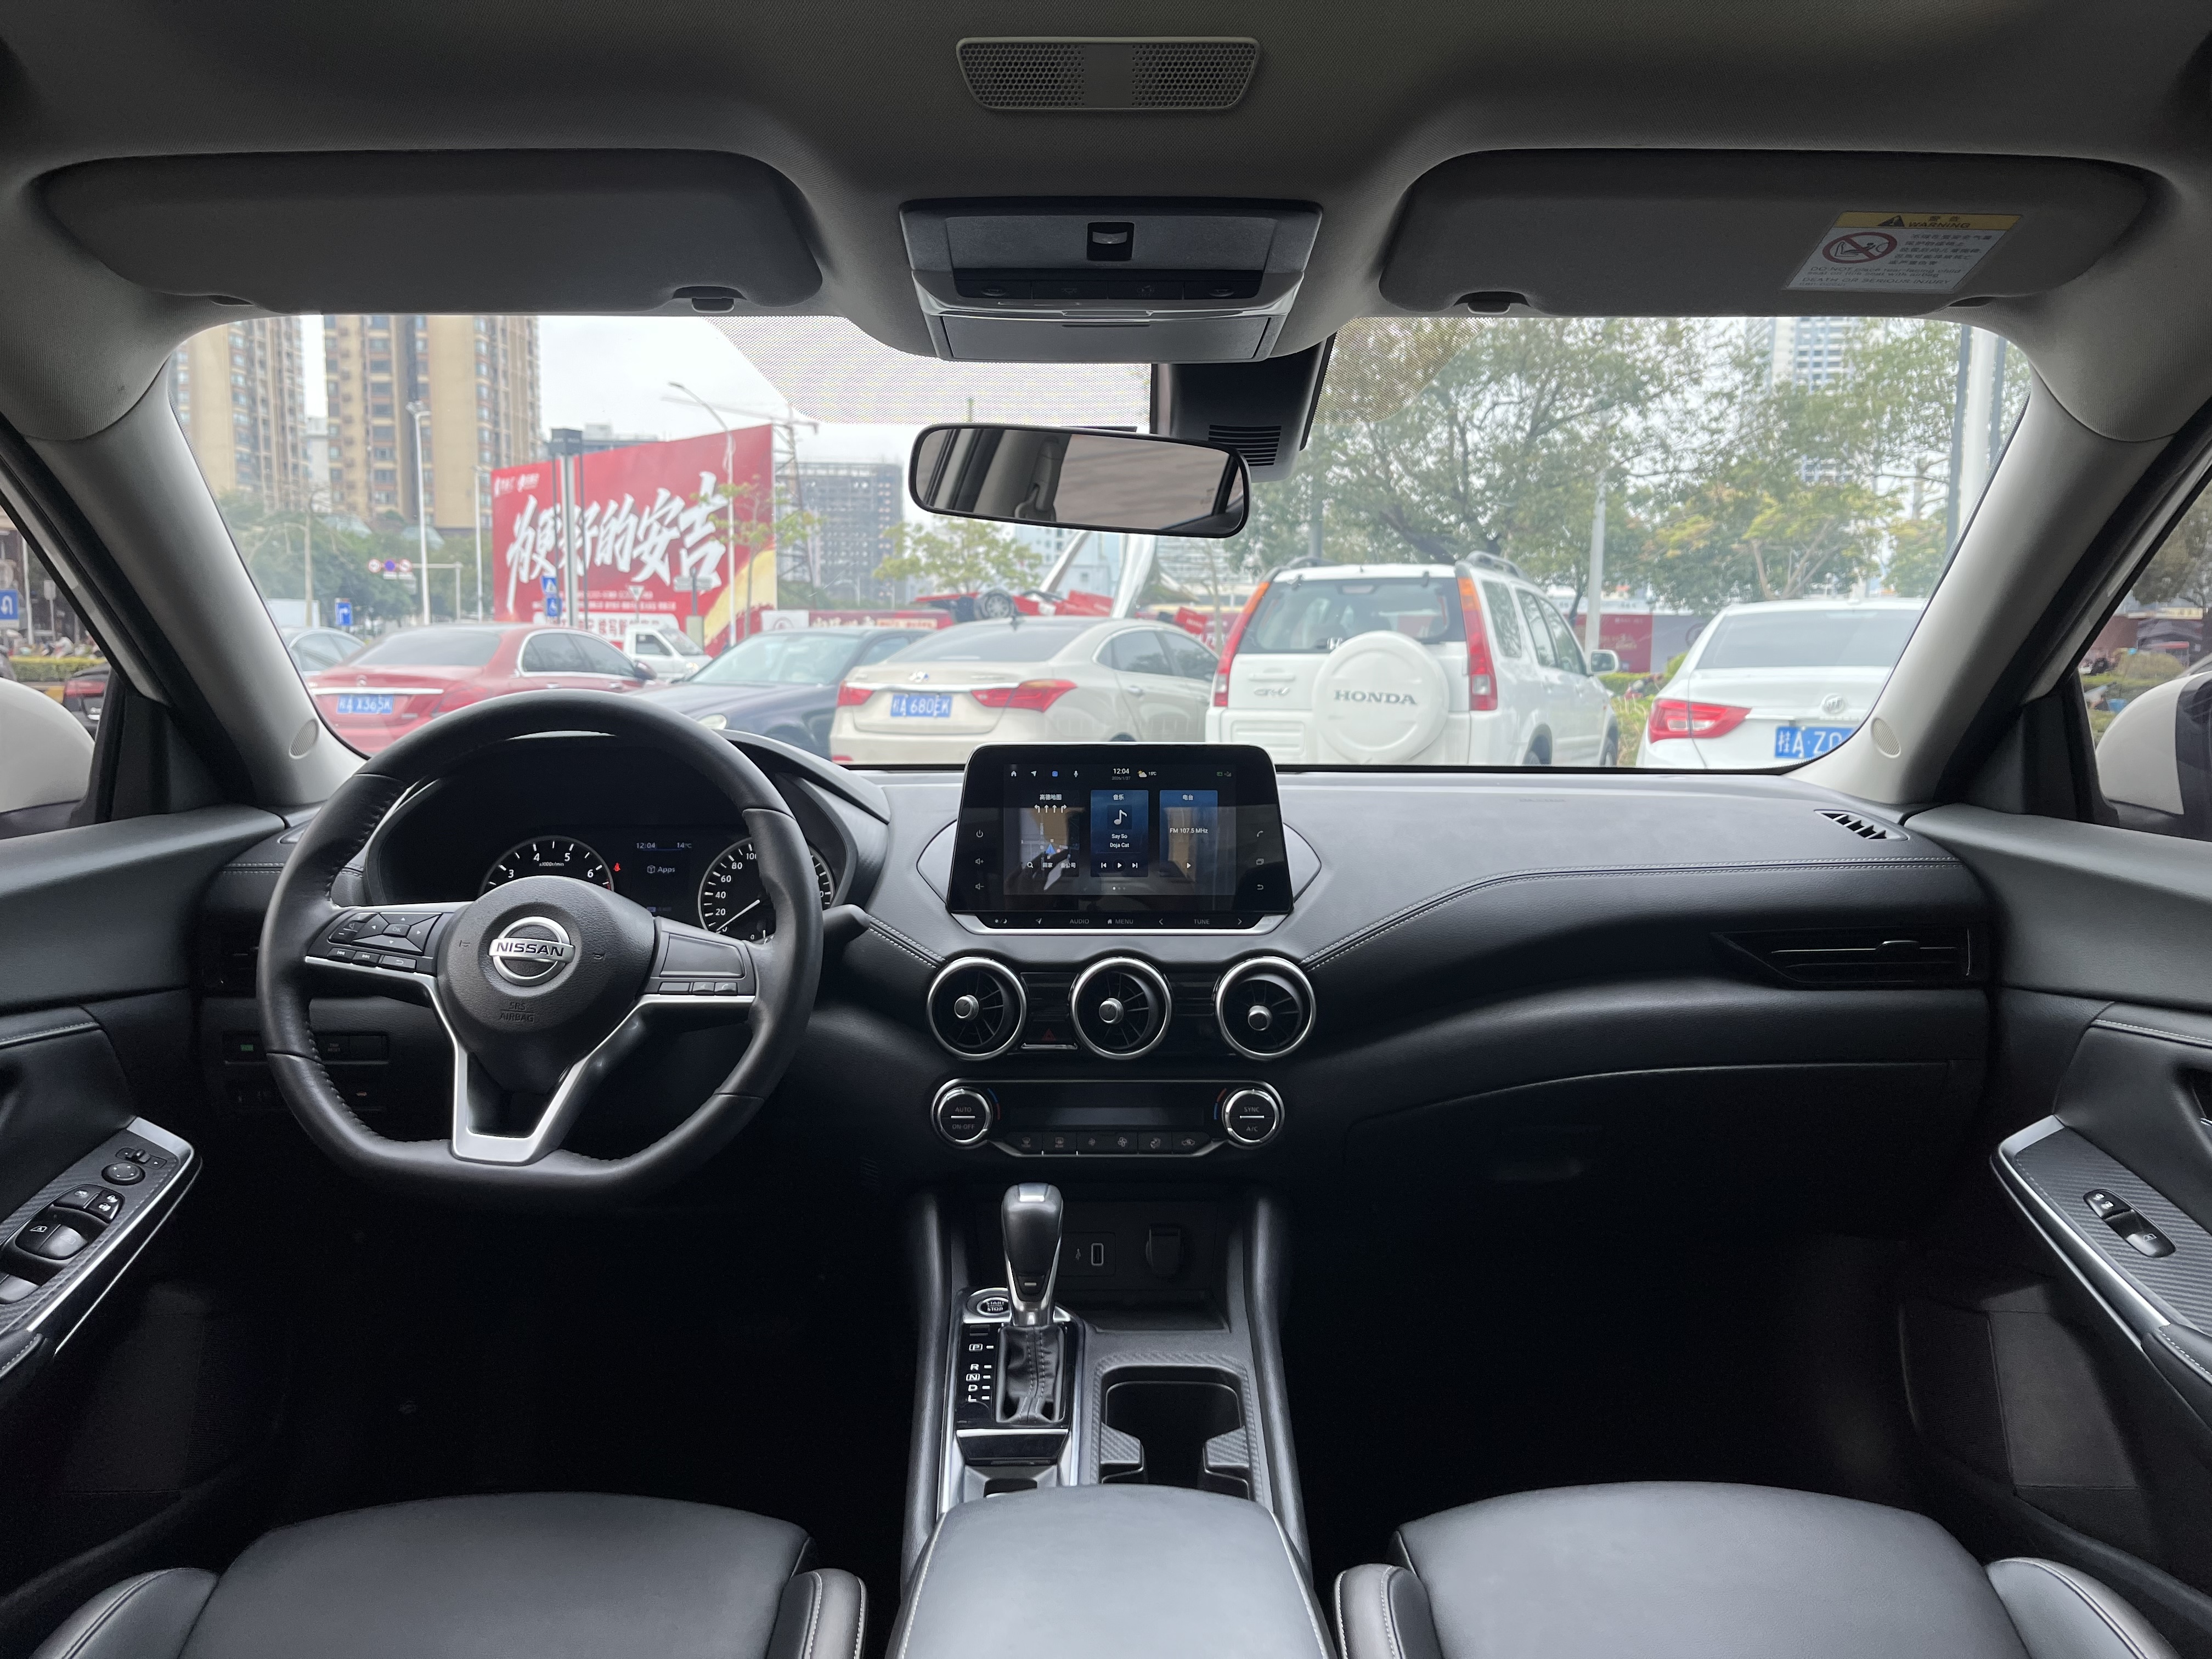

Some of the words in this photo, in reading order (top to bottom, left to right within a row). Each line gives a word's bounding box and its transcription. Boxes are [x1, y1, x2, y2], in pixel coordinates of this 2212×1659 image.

[1334, 690, 1418, 705] HONDA
[534, 853, 540, 861] 4
[565, 853, 571, 861] 5
[508, 870, 515, 878] 3
[586, 869, 594, 878] 6
[657, 866, 676, 874] Apps
[495, 941, 565, 957] NISSAN
[508, 1002, 526, 1010] SRS
[499, 1012, 535, 1023] AIRBAG
